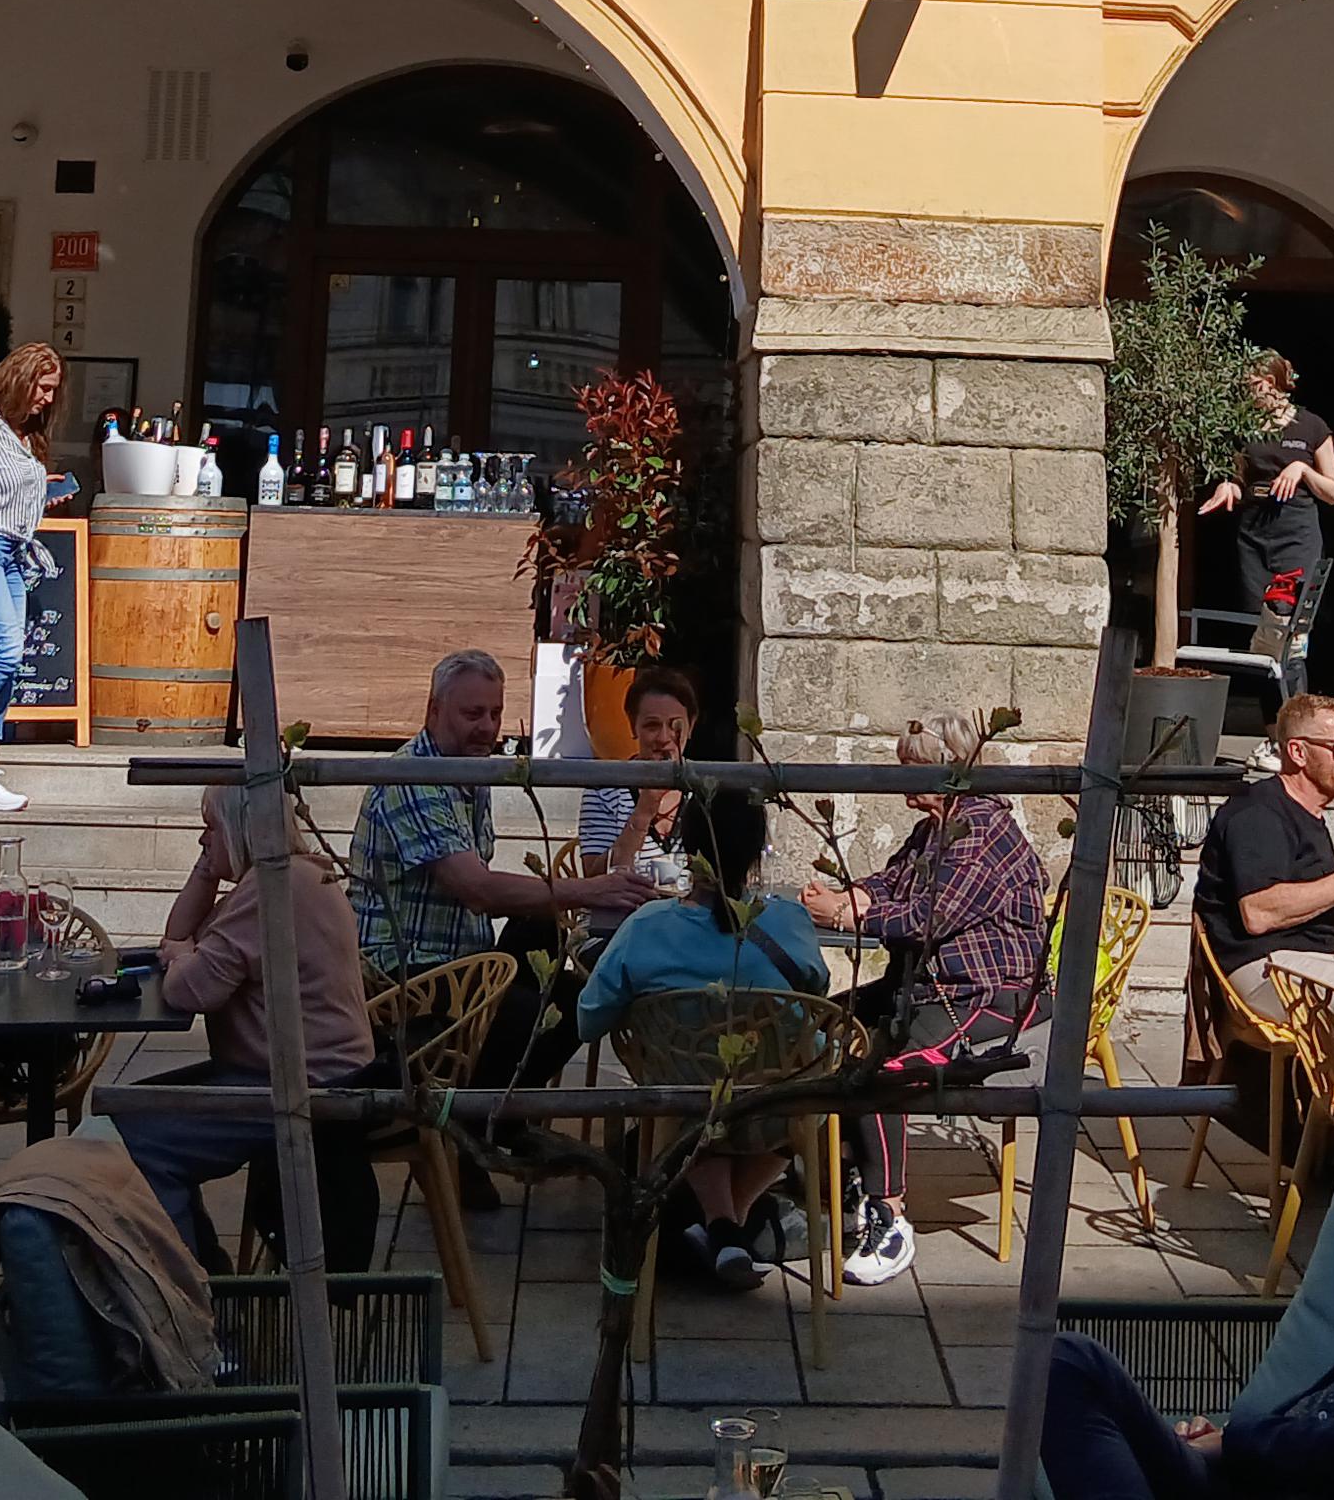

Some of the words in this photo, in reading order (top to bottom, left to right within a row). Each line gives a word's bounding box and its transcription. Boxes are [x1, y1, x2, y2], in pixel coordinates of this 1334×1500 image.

[56, 236, 90, 257] 200
[65, 279, 76, 296] 2
[65, 304, 75, 321] 3
